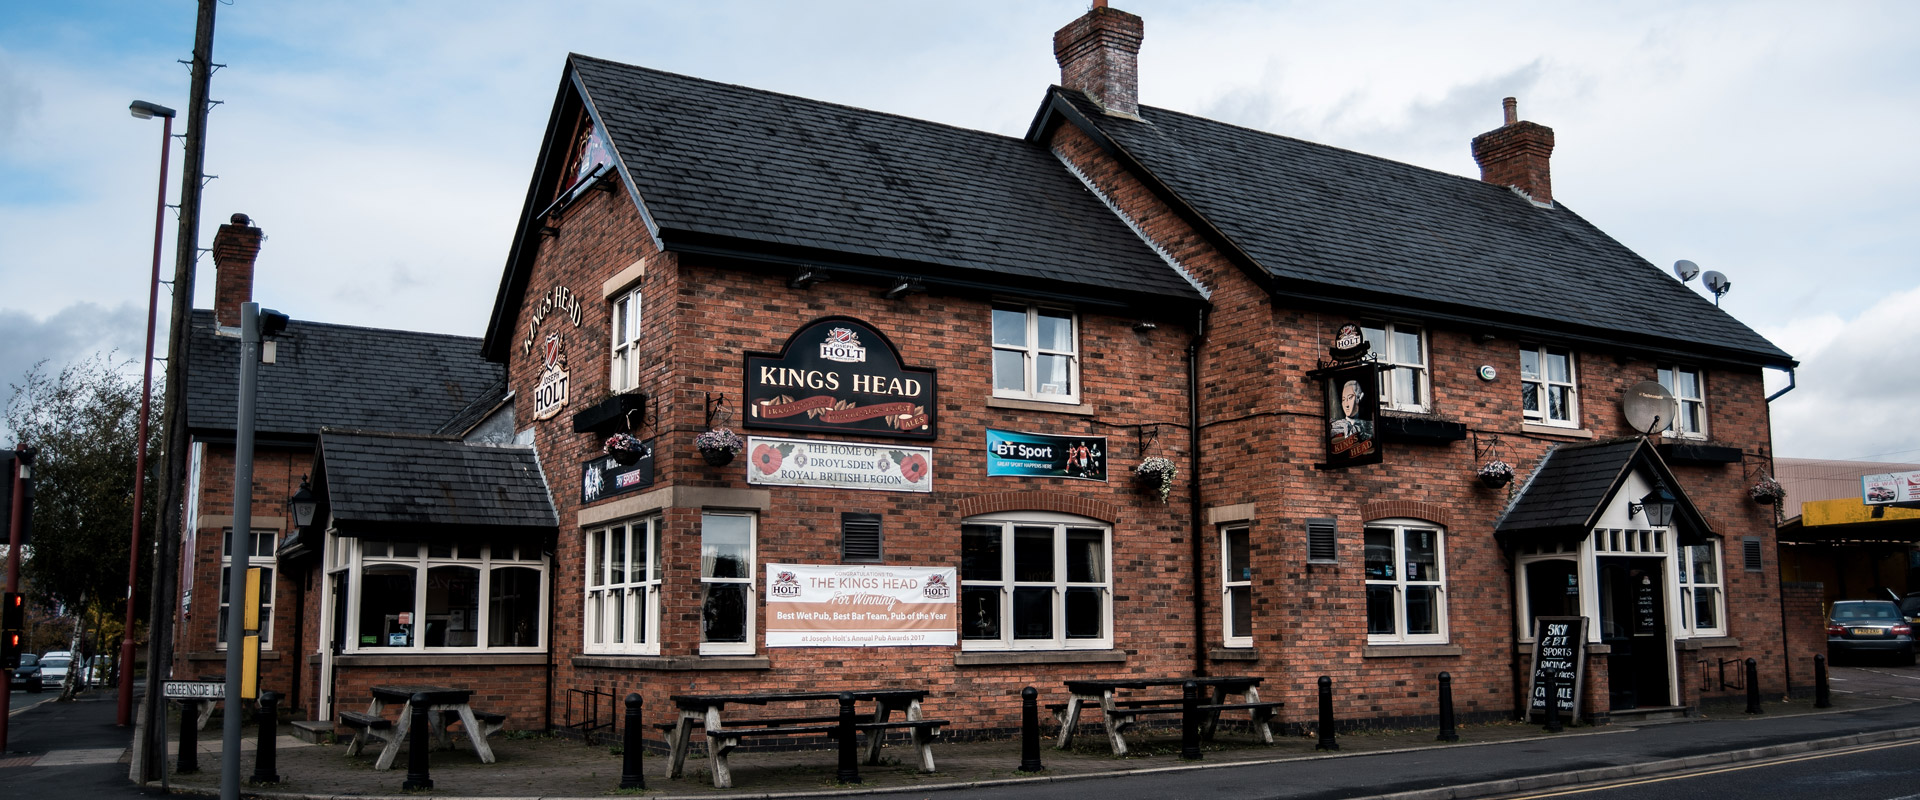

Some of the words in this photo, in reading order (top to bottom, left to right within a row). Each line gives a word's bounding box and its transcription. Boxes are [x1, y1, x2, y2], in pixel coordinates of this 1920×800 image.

[524, 290, 552, 355] KINGS
[554, 286, 582, 327] HEAD
[1337, 337, 1359, 348] HOLT
[823, 346, 864, 359] HOLT
[760, 366, 840, 390] KINGS
[852, 373, 921, 397] HEAD
[535, 376, 567, 412] HOLT
[905, 416, 925, 428] ALES
[807, 444, 829, 454] THE
[831, 445, 861, 456] HOME
[864, 448, 877, 457] OF
[1334, 435, 1359, 453] KINGS
[1350, 440, 1373, 458] HEAD
[997, 444, 1017, 455] BT
[1018, 444, 1052, 459] Sport
[810, 458, 874, 470] DROYLSDEN
[781, 470, 816, 481] ROYAL
[819, 472, 861, 483] BRITISH
[864, 475, 902, 485] LEGION
[773, 586, 800, 594] HOLT
[809, 577, 835, 589] THE
[839, 577, 879, 589] KINGS
[883, 578, 918, 590] HEAD
[924, 588, 949, 596] HOLT
[831, 591, 851, 605] For
[852, 592, 897, 611] Winning
[776, 612, 794, 620] Best
[795, 612, 813, 620] Wet
[813, 612, 832, 621] Pub,
[833, 612, 850, 620] Best
[851, 612, 865, 620] Bar
[866, 612, 890, 622] Team,
[891, 612, 906, 620] Pub
[907, 612, 916, 620] of
[916, 612, 929, 620] the
[930, 612, 947, 620] Year
[1547, 623, 1568, 636] SKY
[809, 635, 831, 643] Joseph
[832, 634, 851, 642] Holt's
[852, 634, 874, 642] Annual
[1542, 647, 1572, 657] SPORTS
[1541, 660, 1567, 669] RACING
[166, 683, 210, 696] GREENSIDE
[212, 684, 226, 696] LA
[1556, 687, 1573, 699] ALE
